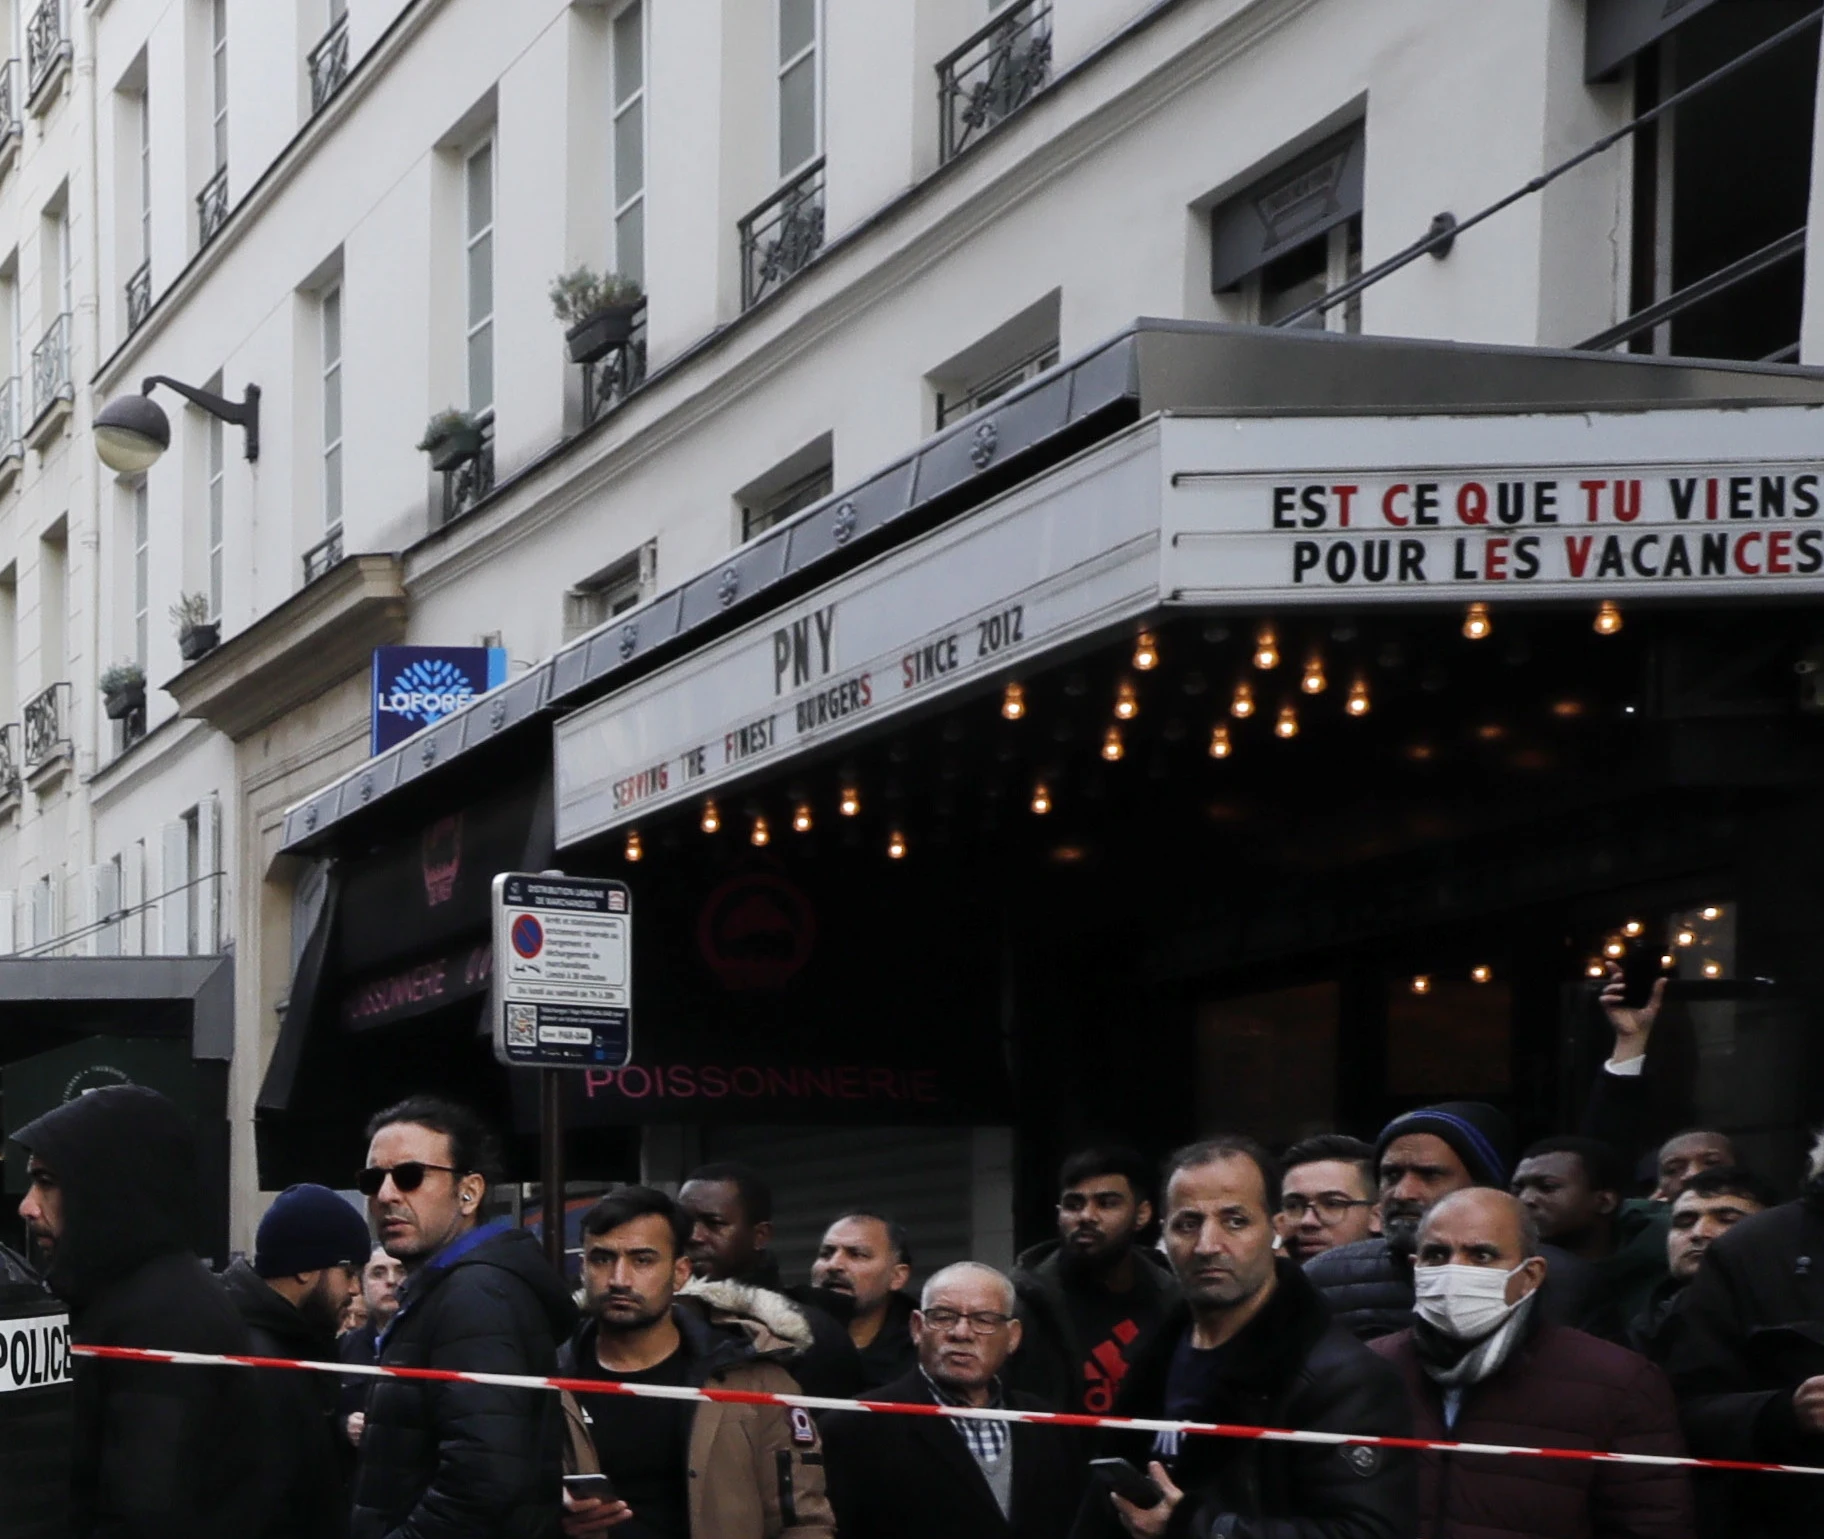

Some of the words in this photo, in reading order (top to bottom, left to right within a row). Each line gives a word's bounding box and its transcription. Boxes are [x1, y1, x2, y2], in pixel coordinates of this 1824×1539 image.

[1273, 484, 1358, 529] EST
[1382, 483, 1440, 528] CE
[1456, 480, 1558, 525] QUE
[1580, 479, 1642, 523] TU
[1669, 474, 1820, 521] VIENS
[1292, 537, 1426, 584] POUR
[1455, 535, 1541, 581] LES
[1564, 530, 1824, 579] VACANCES
[774, 603, 836, 696] PNY
[612, 763, 668, 811] SERVING
[681, 744, 706, 781] THE
[724, 715, 776, 762] FINEST
[796, 672, 873, 736] BURGERS
[902, 632, 958, 690] SINCE
[976, 604, 1026, 658] 2012
[585, 1063, 943, 1103] POISSONNERIE
